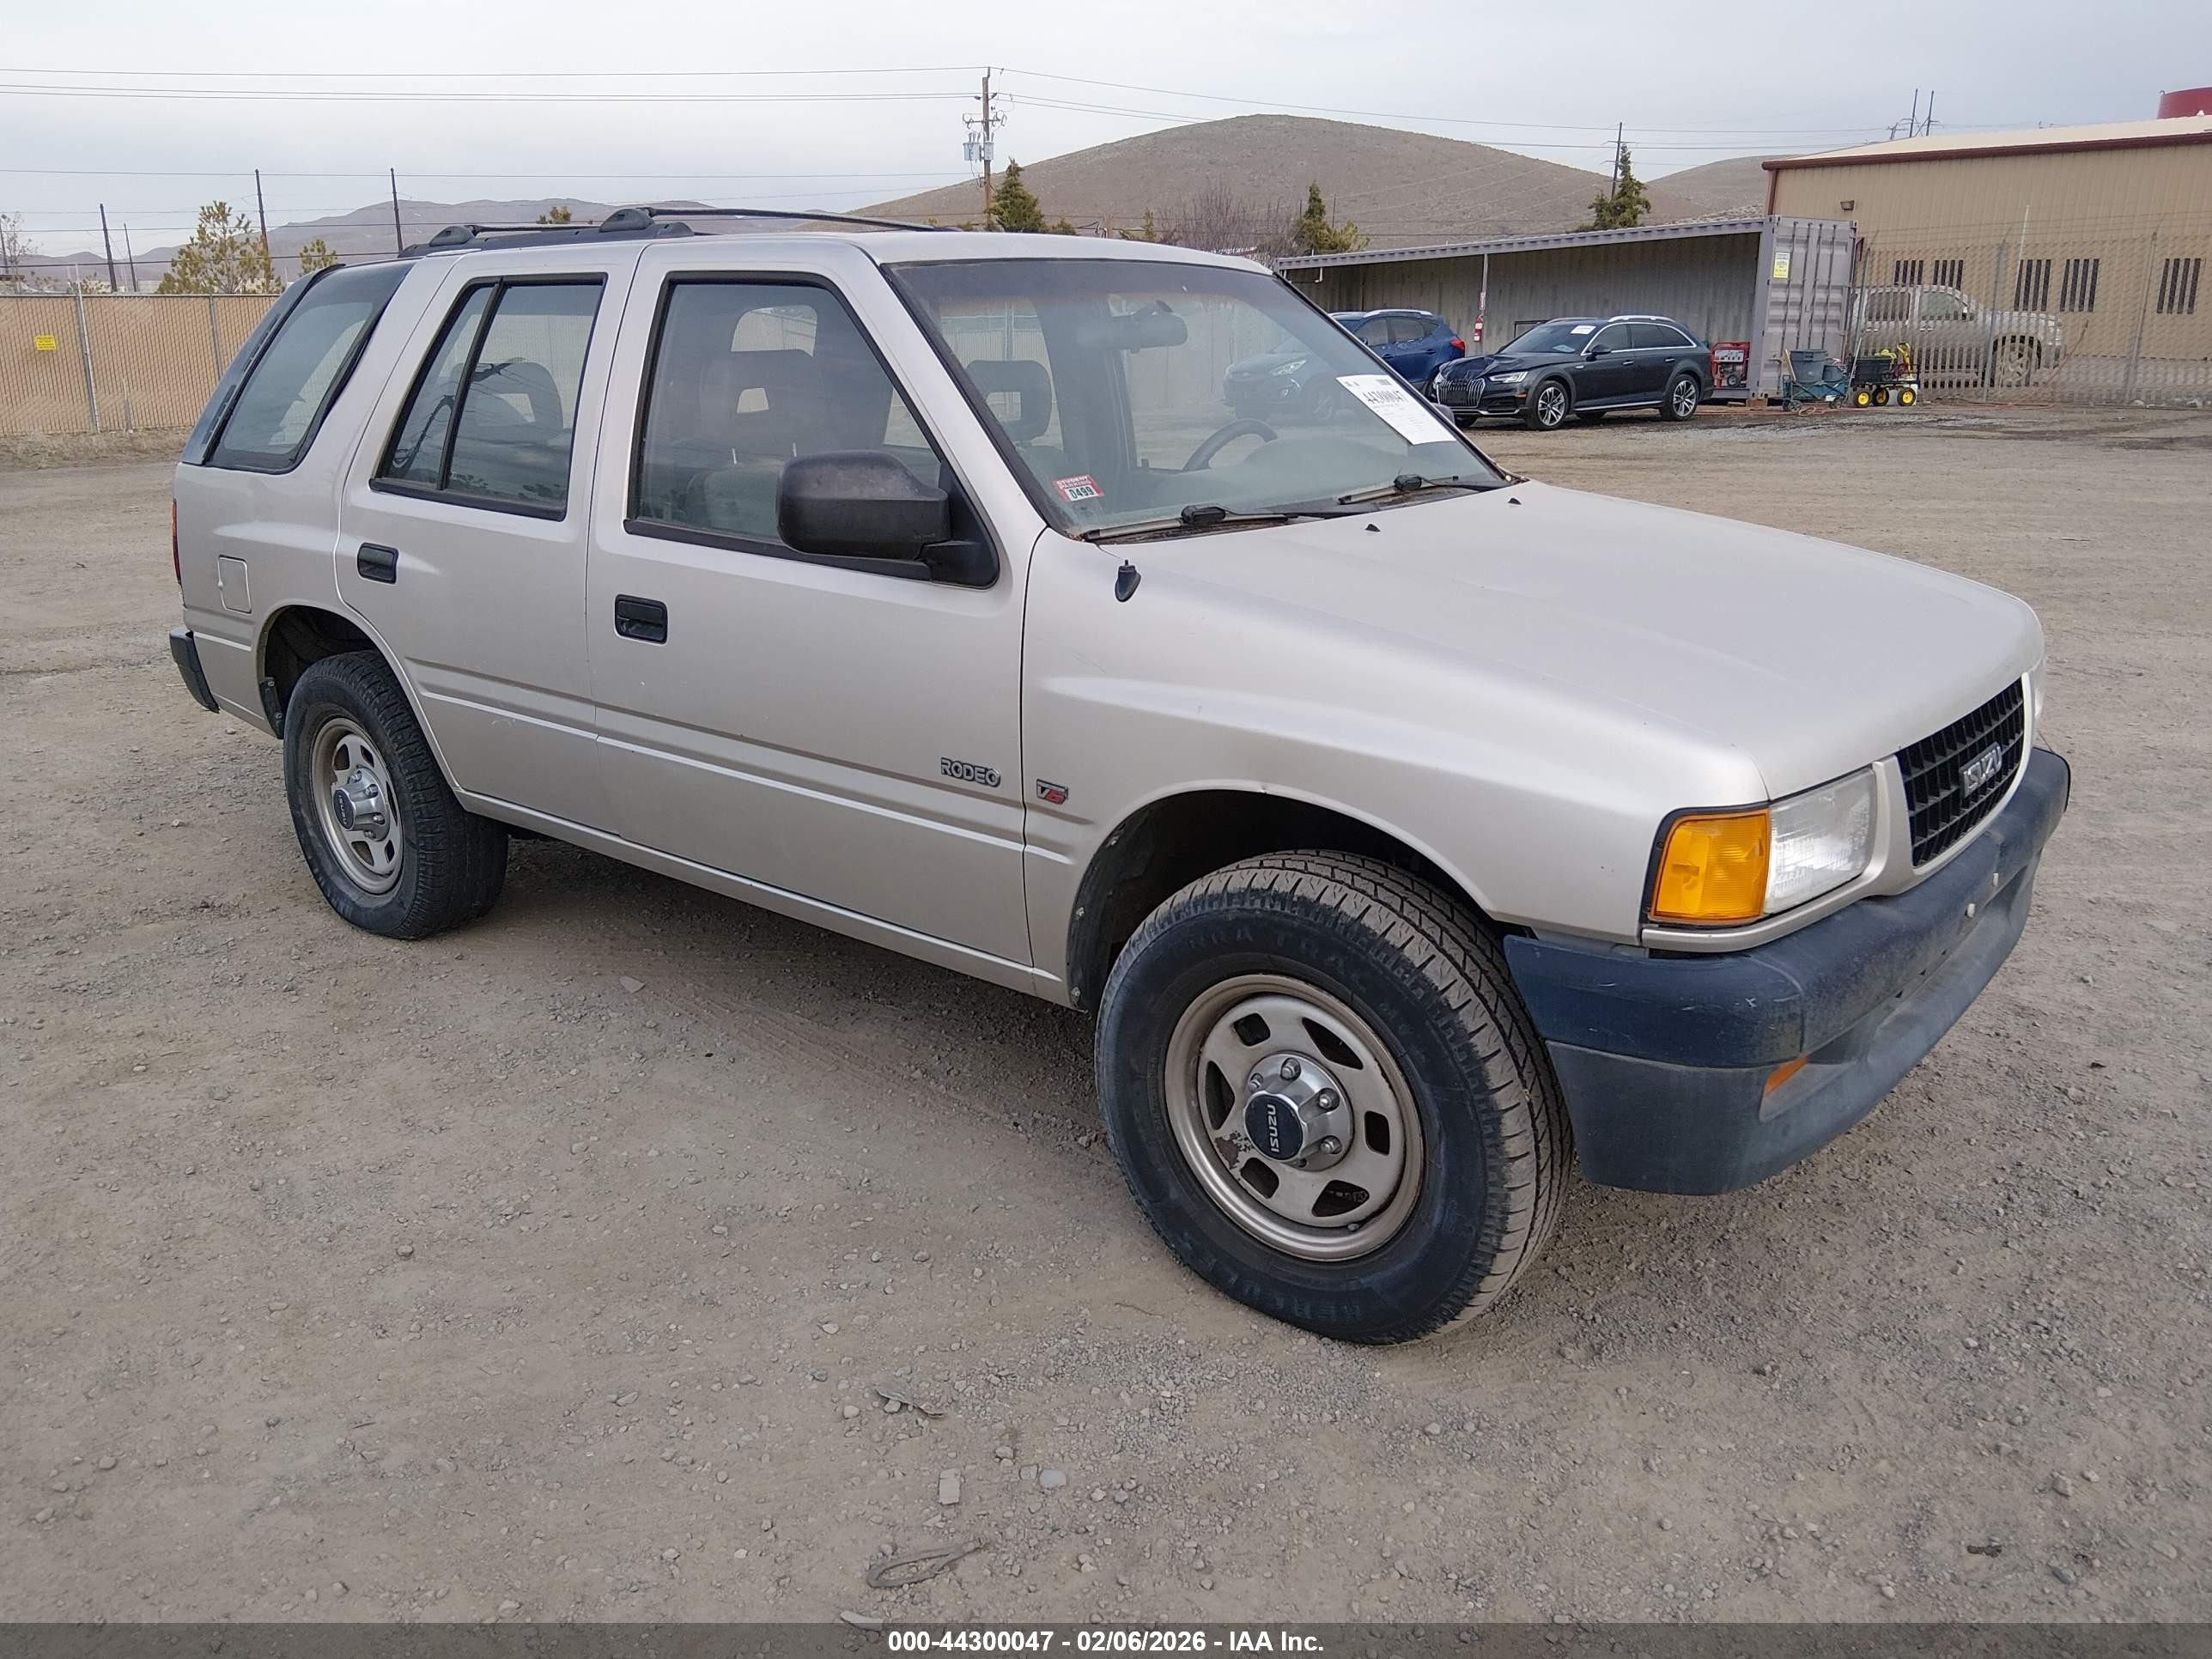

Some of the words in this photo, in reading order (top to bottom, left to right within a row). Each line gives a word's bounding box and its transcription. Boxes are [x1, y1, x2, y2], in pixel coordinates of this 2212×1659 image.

[1069, 486, 1095, 499] 0499
[940, 757, 1001, 787] RODEO
[1963, 744, 2003, 799] ISUZU
[1036, 779, 1069, 805] V6
[1267, 1104, 1280, 1153] ISUZU
